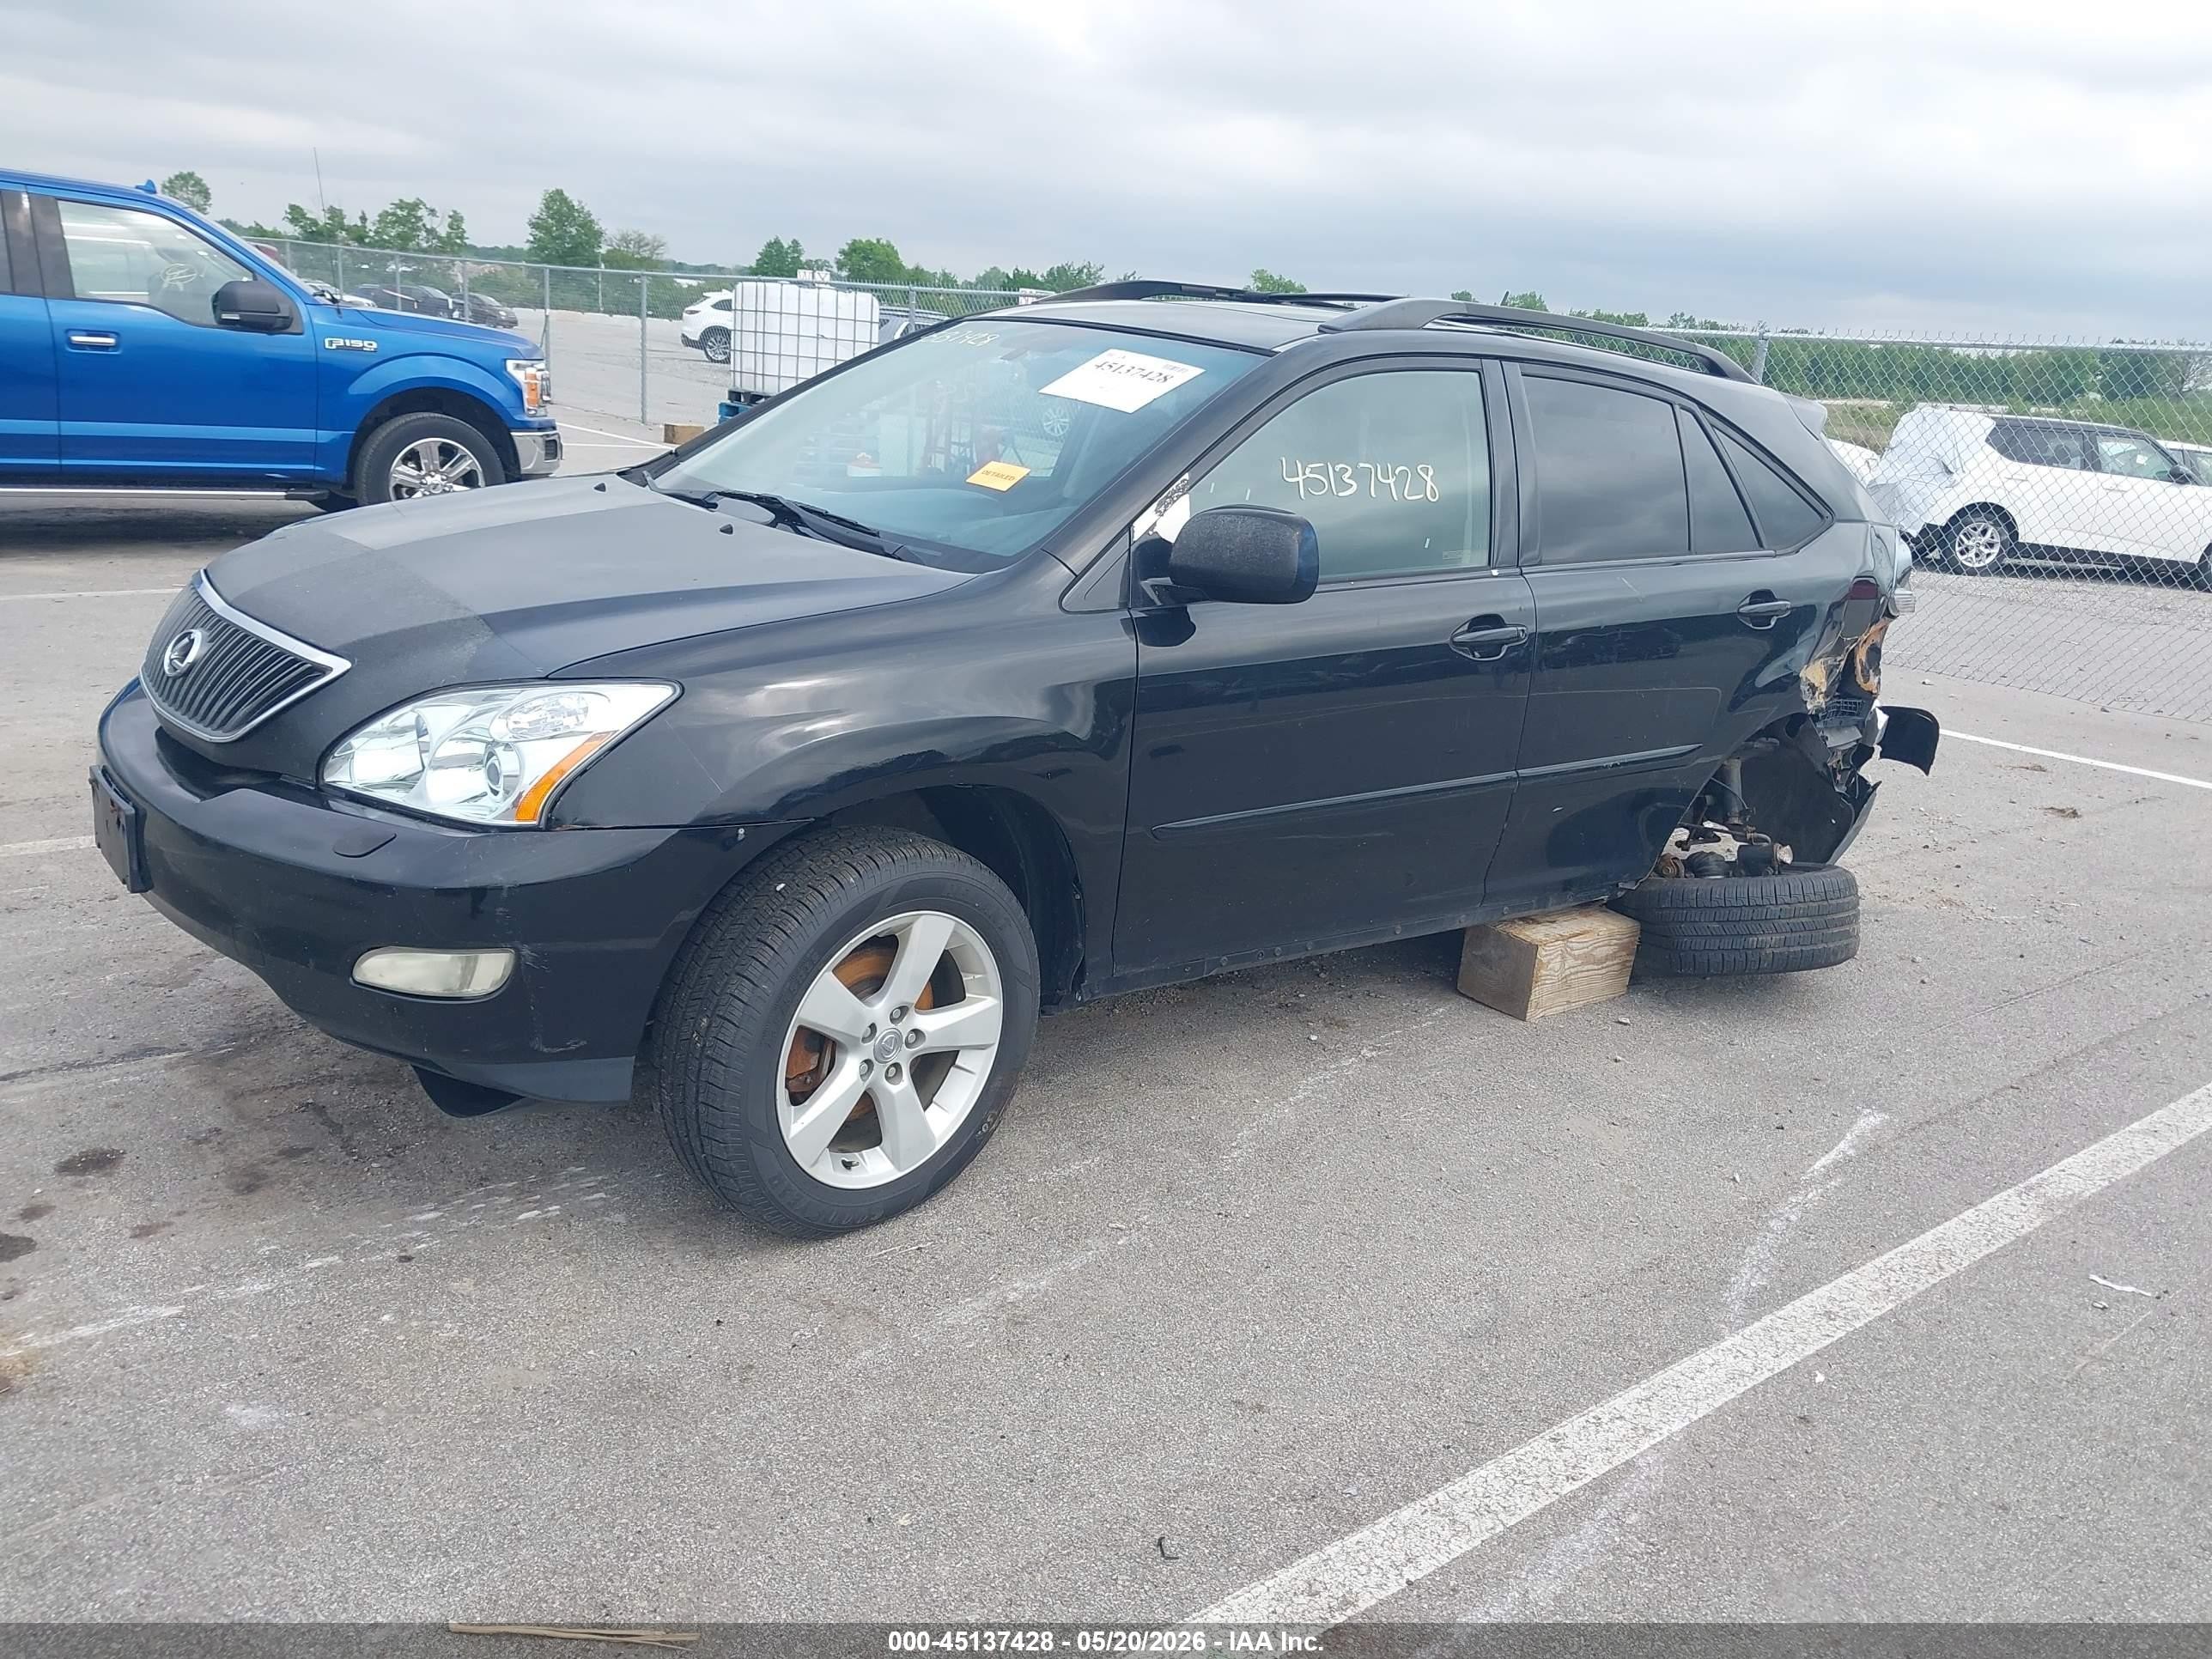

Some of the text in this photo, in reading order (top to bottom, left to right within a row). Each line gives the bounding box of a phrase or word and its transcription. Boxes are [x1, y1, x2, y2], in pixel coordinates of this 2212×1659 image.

[324, 337, 378, 349] F150
[1094, 361, 1174, 383] 45137428
[981, 469, 1016, 482] DETAILED
[1280, 456, 1440, 502] 45137428
